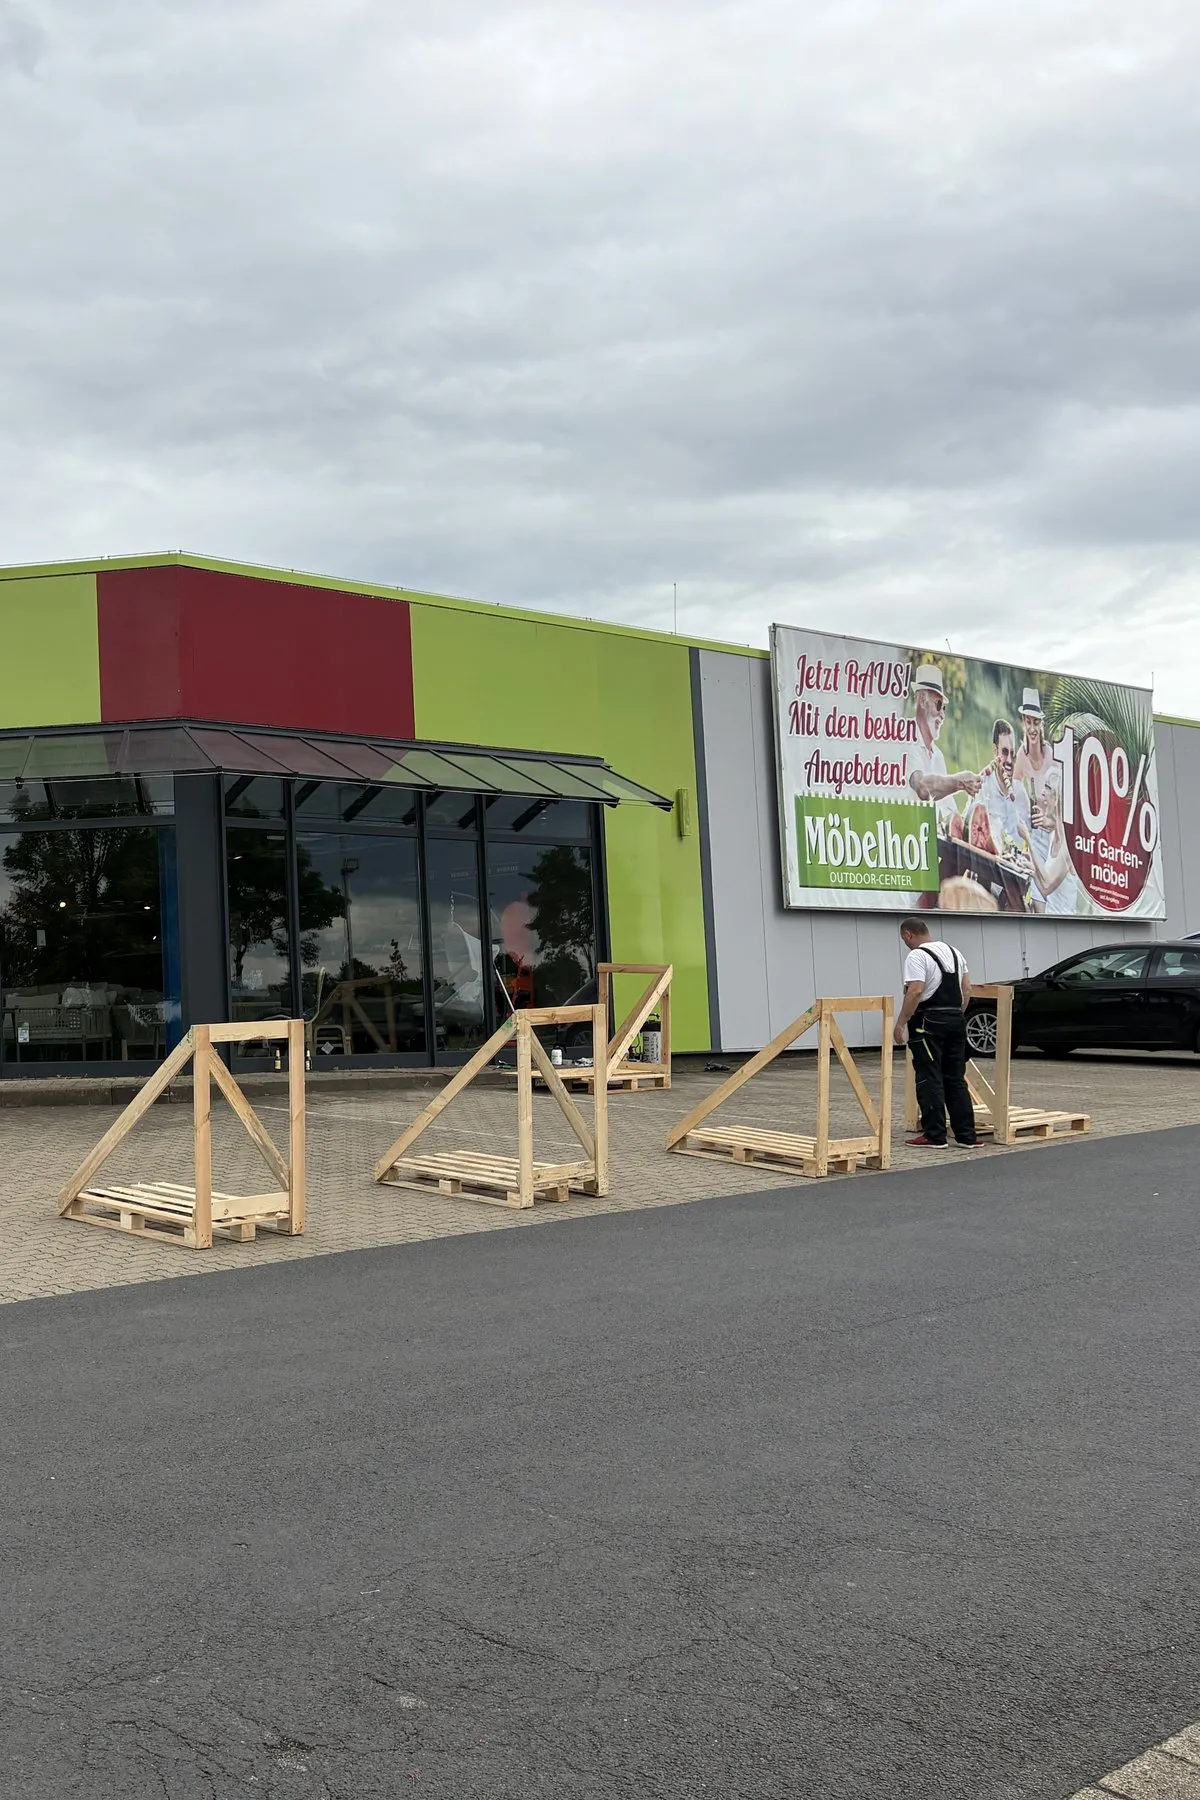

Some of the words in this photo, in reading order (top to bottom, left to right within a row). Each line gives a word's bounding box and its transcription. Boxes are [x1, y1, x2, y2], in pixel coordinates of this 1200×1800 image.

[795, 654, 840, 697] Jetzt
[845, 659, 911, 698] RAUS!
[788, 700, 820, 736] Mit
[825, 706, 859, 739] den
[864, 708, 917, 743] besten
[804, 749, 907, 794] Angeboten!
[1052, 725, 1158, 852] 10%
[804, 812, 930, 871] Möbelhof
[1074, 835, 1095, 853] auf
[1098, 838, 1143, 869] Garten-
[830, 871, 912, 886] OUTDOOR-CENTER
[1091, 863, 1129, 889] möbel
